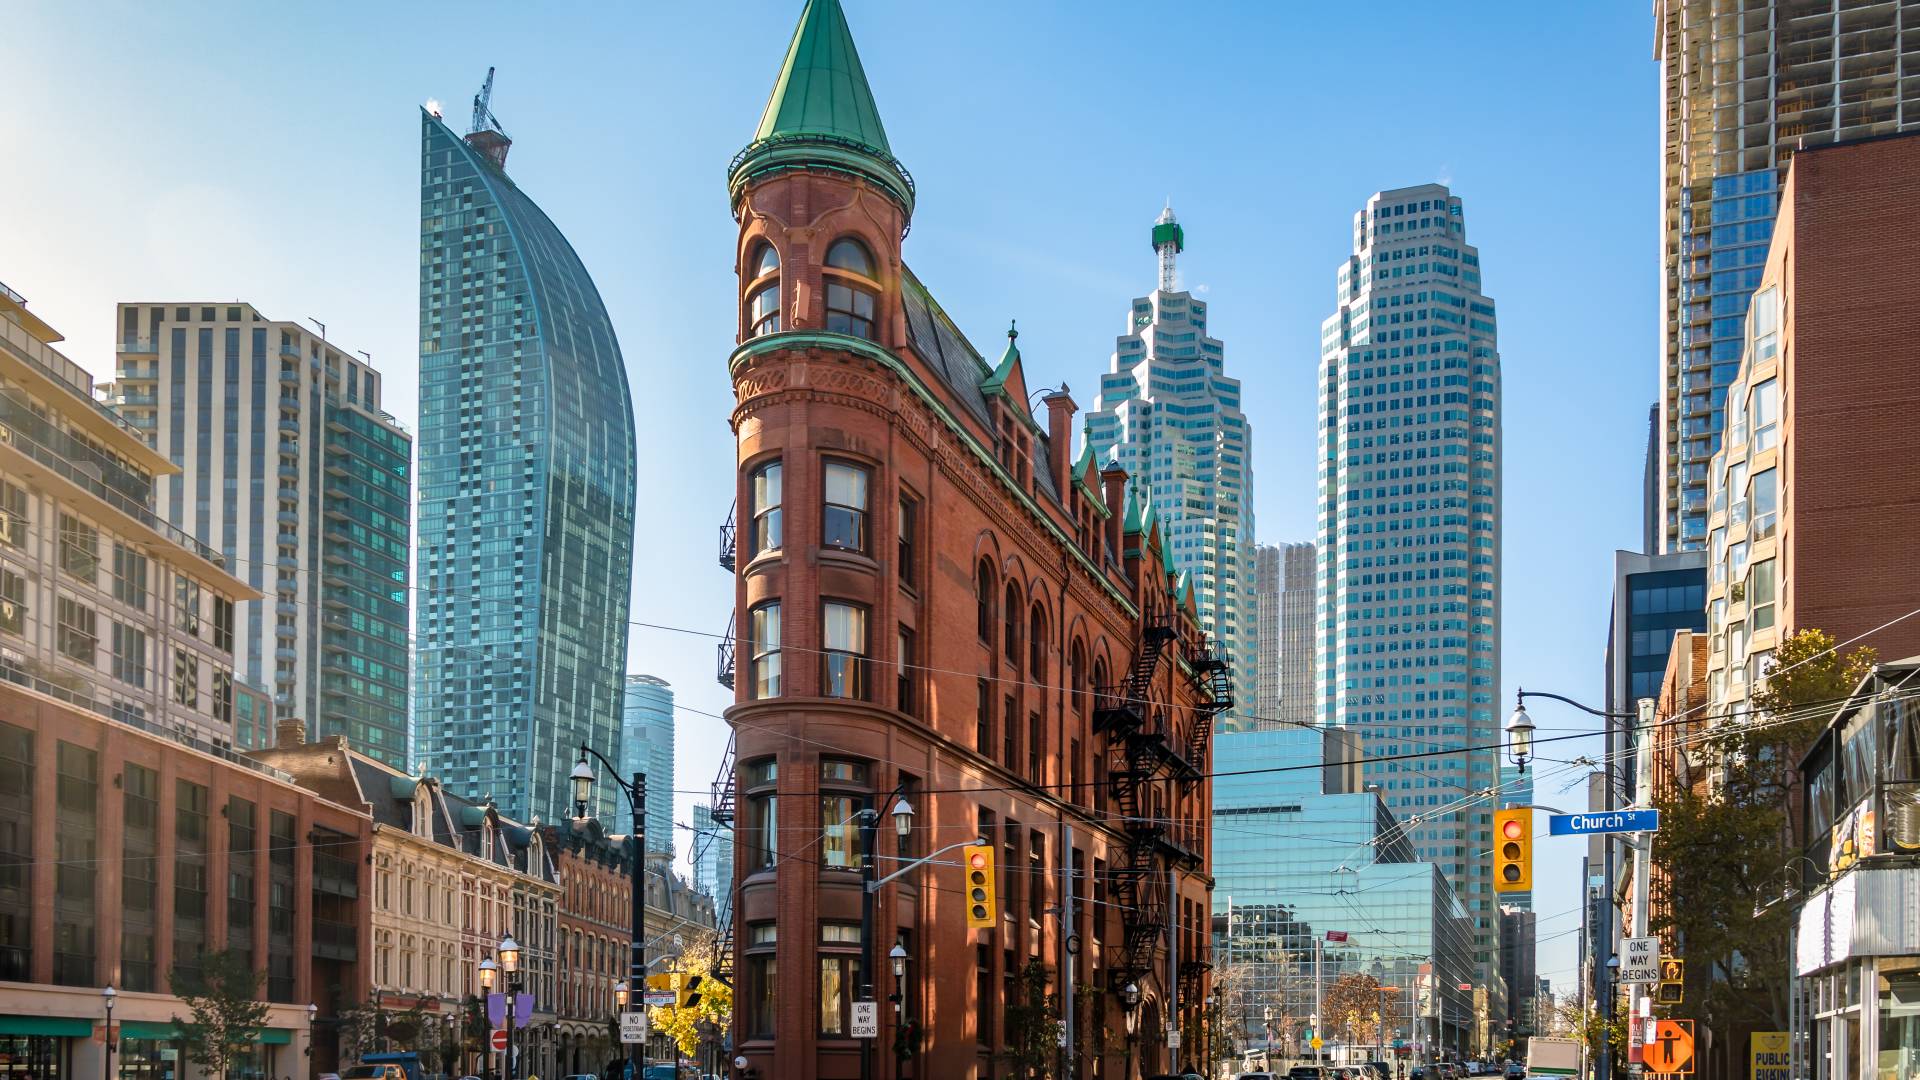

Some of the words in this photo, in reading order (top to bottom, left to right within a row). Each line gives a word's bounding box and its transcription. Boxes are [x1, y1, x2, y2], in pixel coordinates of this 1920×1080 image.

[1570, 813, 1624, 830] Church
[1627, 812, 1636, 821] St
[1629, 941, 1649, 952] ONE
[1629, 955, 1649, 966] WAY
[1622, 969, 1657, 980] BEGINS
[857, 1004, 871, 1014] ONE
[629, 1015, 639, 1025] NO
[857, 1015, 871, 1024] WAY
[852, 1025, 876, 1035] BEGINS
[1755, 1052, 1791, 1066] PUBLIC
